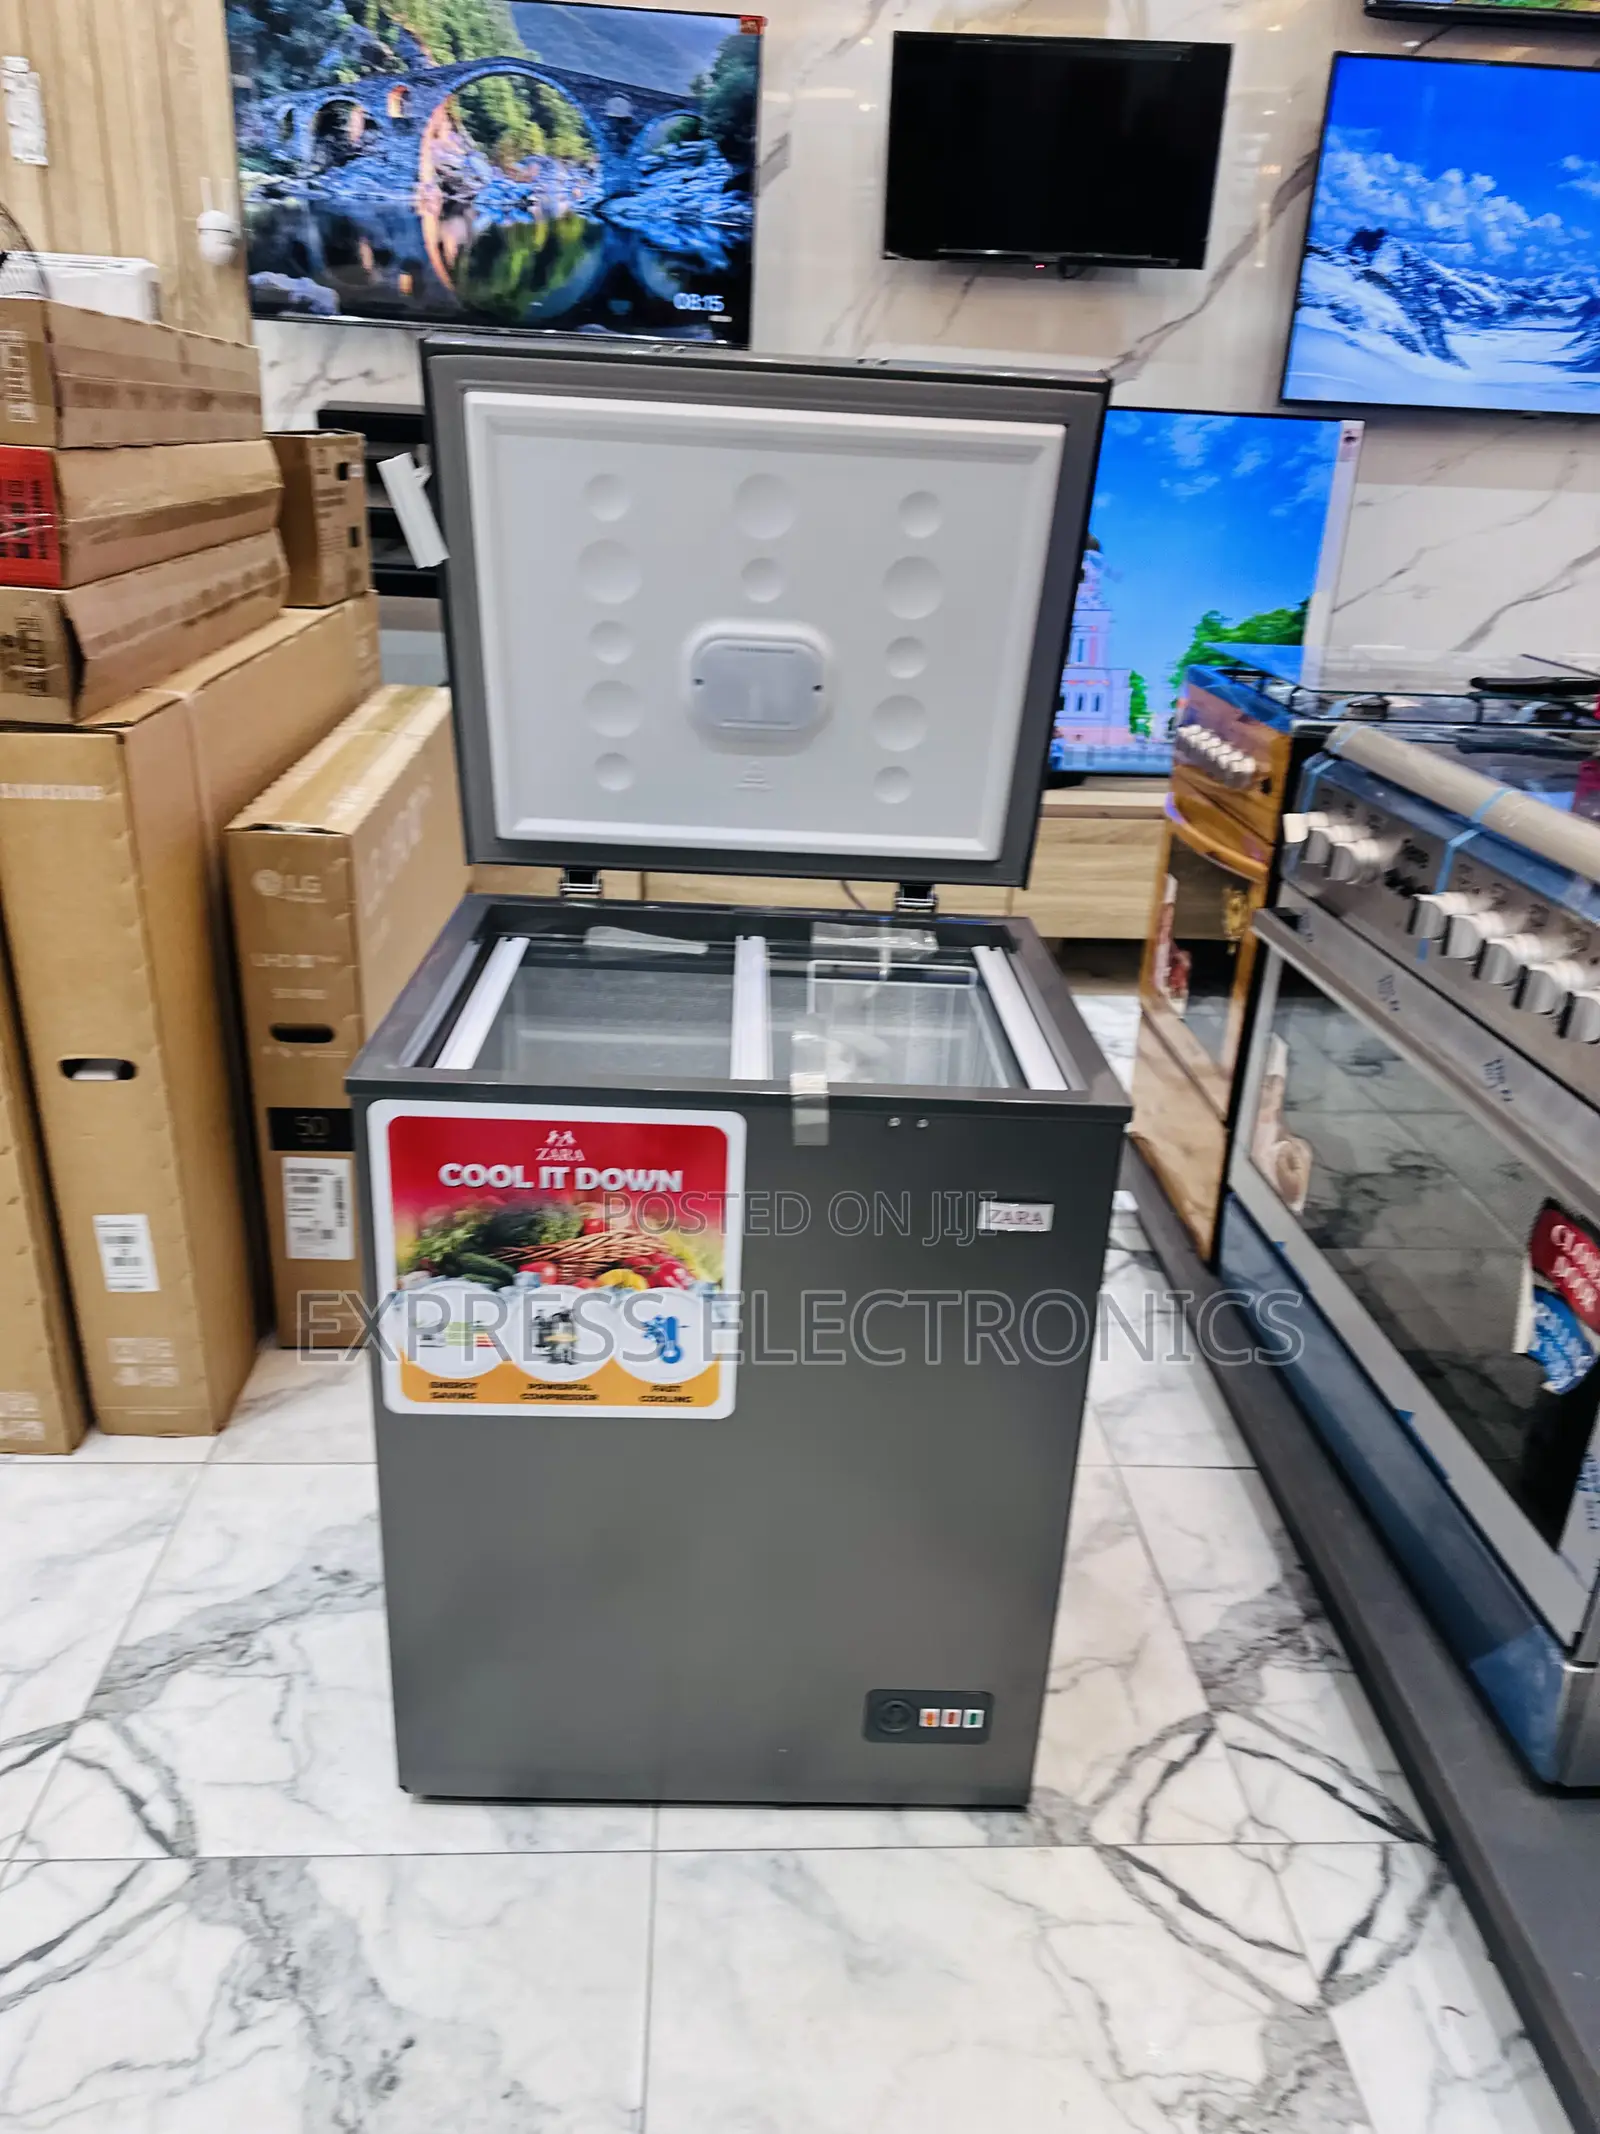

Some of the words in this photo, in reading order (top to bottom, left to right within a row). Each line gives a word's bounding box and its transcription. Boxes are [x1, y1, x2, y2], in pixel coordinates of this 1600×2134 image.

[283, 874, 322, 893] LG
[535, 1148, 586, 1162] ZARA
[438, 1162, 534, 1189] COOL
[538, 1165, 571, 1190] IT
[574, 1167, 684, 1193] DOWN
[987, 1208, 1044, 1226] ZARA
